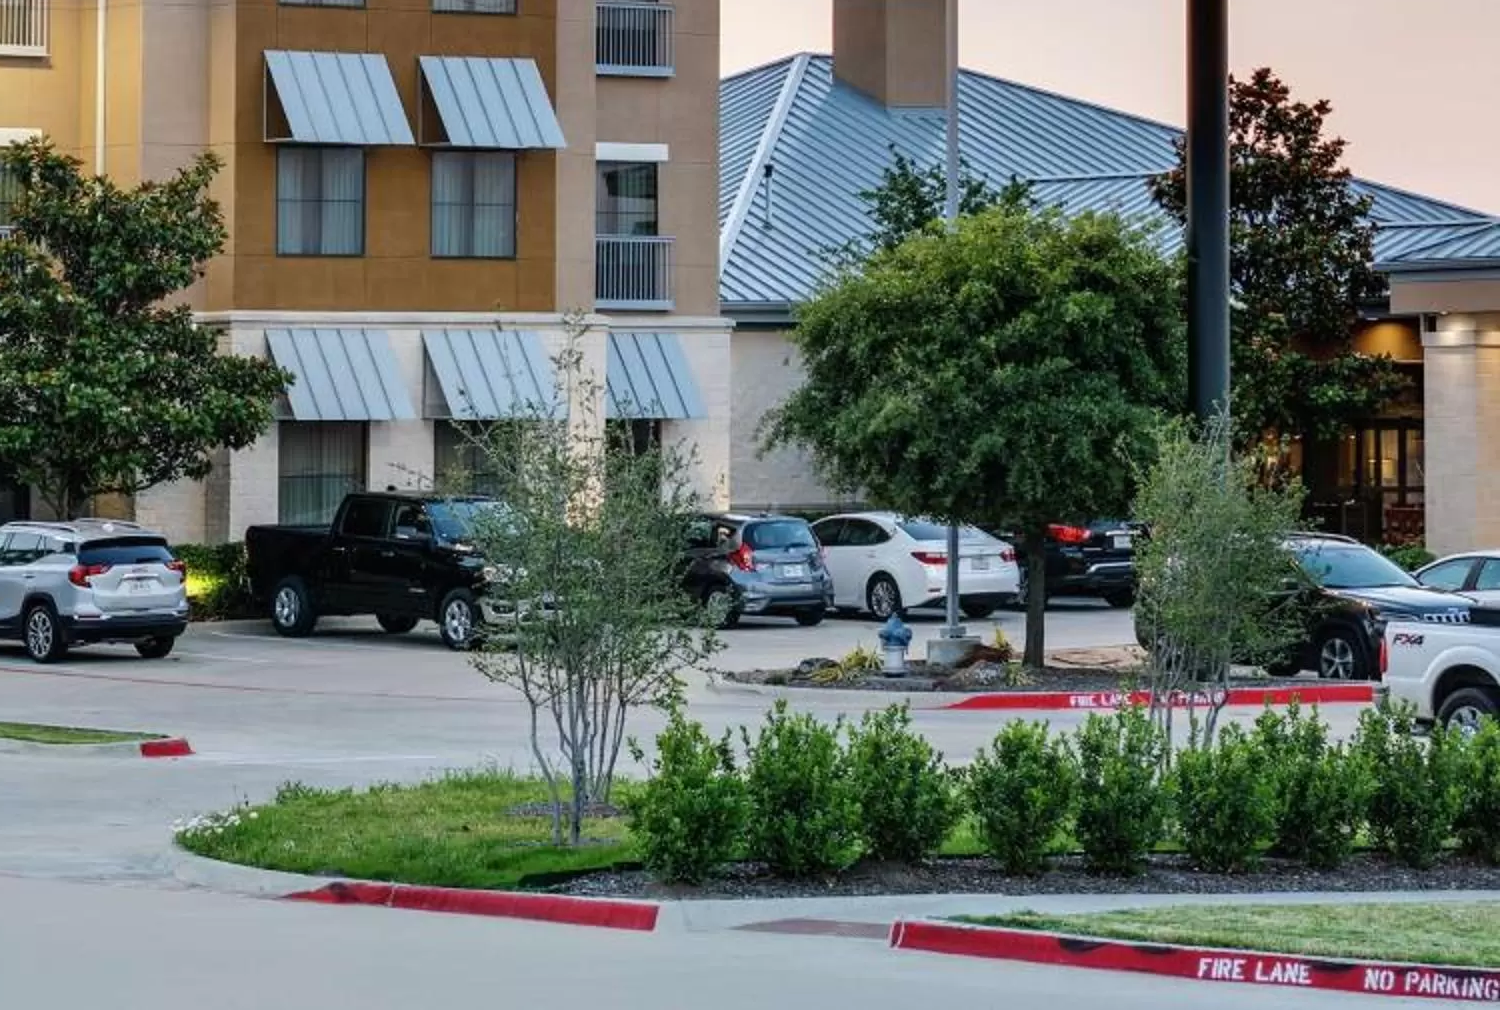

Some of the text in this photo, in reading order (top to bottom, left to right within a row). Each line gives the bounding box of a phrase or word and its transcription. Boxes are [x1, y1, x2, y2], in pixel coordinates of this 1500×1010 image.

[1393, 633, 1424, 646] FX4
[1197, 957, 1500, 1001] FIRE LANE NO PARKING
